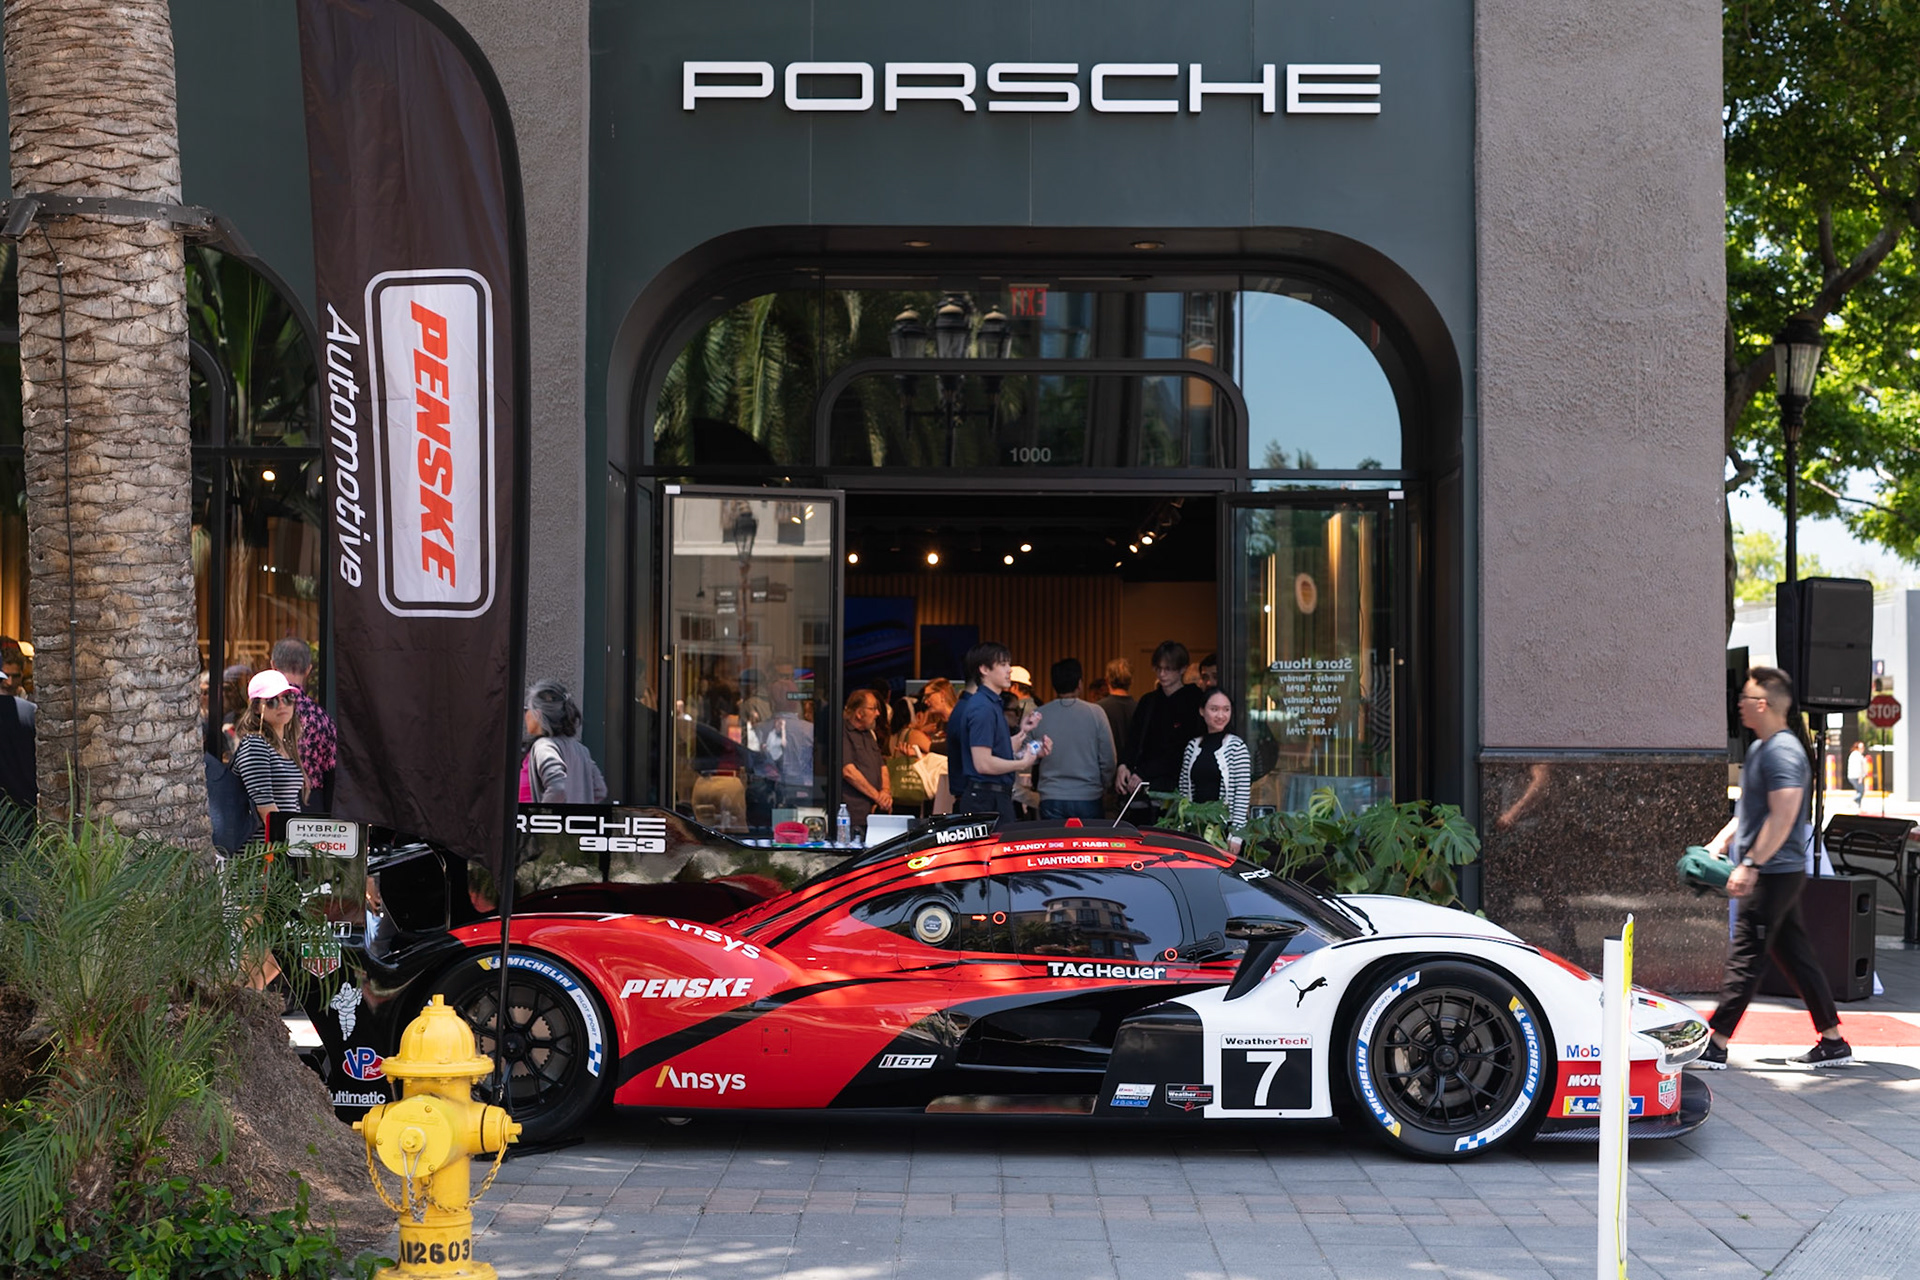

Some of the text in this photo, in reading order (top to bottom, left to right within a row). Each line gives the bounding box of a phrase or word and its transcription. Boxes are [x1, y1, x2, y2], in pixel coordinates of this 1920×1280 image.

[683, 61, 1381, 114] PORSCHE
[326, 302, 371, 588] Automotive
[410, 300, 457, 589] PENSKE
[1010, 447, 1051, 462] 1000
[1869, 704, 1900, 720] STOP
[579, 836, 666, 853] 963
[936, 826, 973, 844] Mobil
[1014, 843, 1047, 851] TANDY
[1027, 855, 1091, 867] L. VANTHOOR
[648, 917, 761, 960] Ansys
[506, 957, 573, 988] MICHELIN
[619, 978, 754, 999] PENSKE
[575, 994, 598, 1036] PILOT SPORT
[1363, 1017, 1374, 1036] PILOT
[1225, 1037, 1308, 1046] WeatherTech
[1566, 1044, 1601, 1058] Mob
[344, 1047, 377, 1080] VP
[897, 1057, 933, 1066] GTP
[1522, 1021, 1539, 1093] MICHELIN
[655, 1065, 747, 1095] Ansys
[1246, 1051, 1287, 1107] 7
[1357, 1046, 1385, 1116] MICHELIN
[1567, 1074, 1602, 1087] MOT
[328, 1089, 387, 1105] ultimatic
[1492, 1101, 1525, 1135] PILOT SPORT
